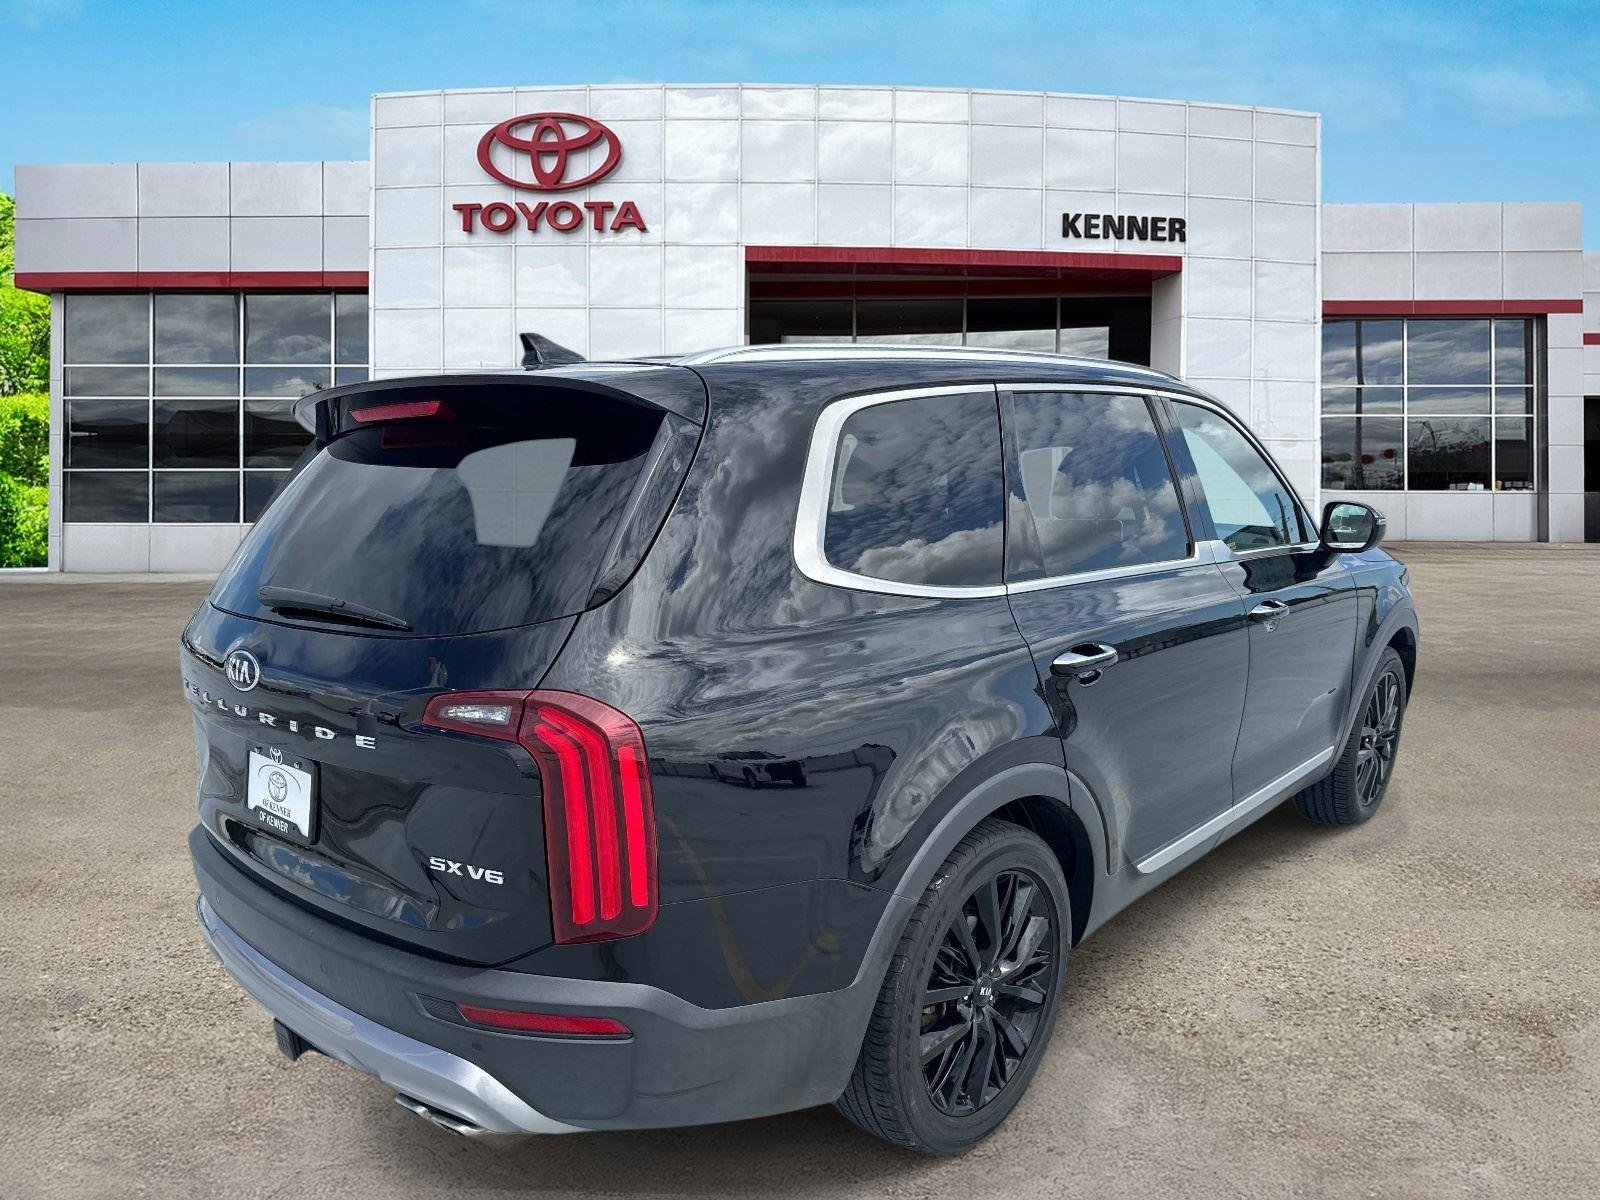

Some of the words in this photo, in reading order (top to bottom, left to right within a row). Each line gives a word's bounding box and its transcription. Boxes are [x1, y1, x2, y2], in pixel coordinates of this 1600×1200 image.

[453, 201, 647, 233] TOYOTA
[1062, 213, 1186, 242] KENNER
[227, 657, 251, 683] KIA
[260, 811, 267, 821] OF
[266, 814, 288, 833] KENNER
[429, 856, 464, 877] SX
[466, 864, 505, 885] V6
[980, 986, 992, 996] KIA
